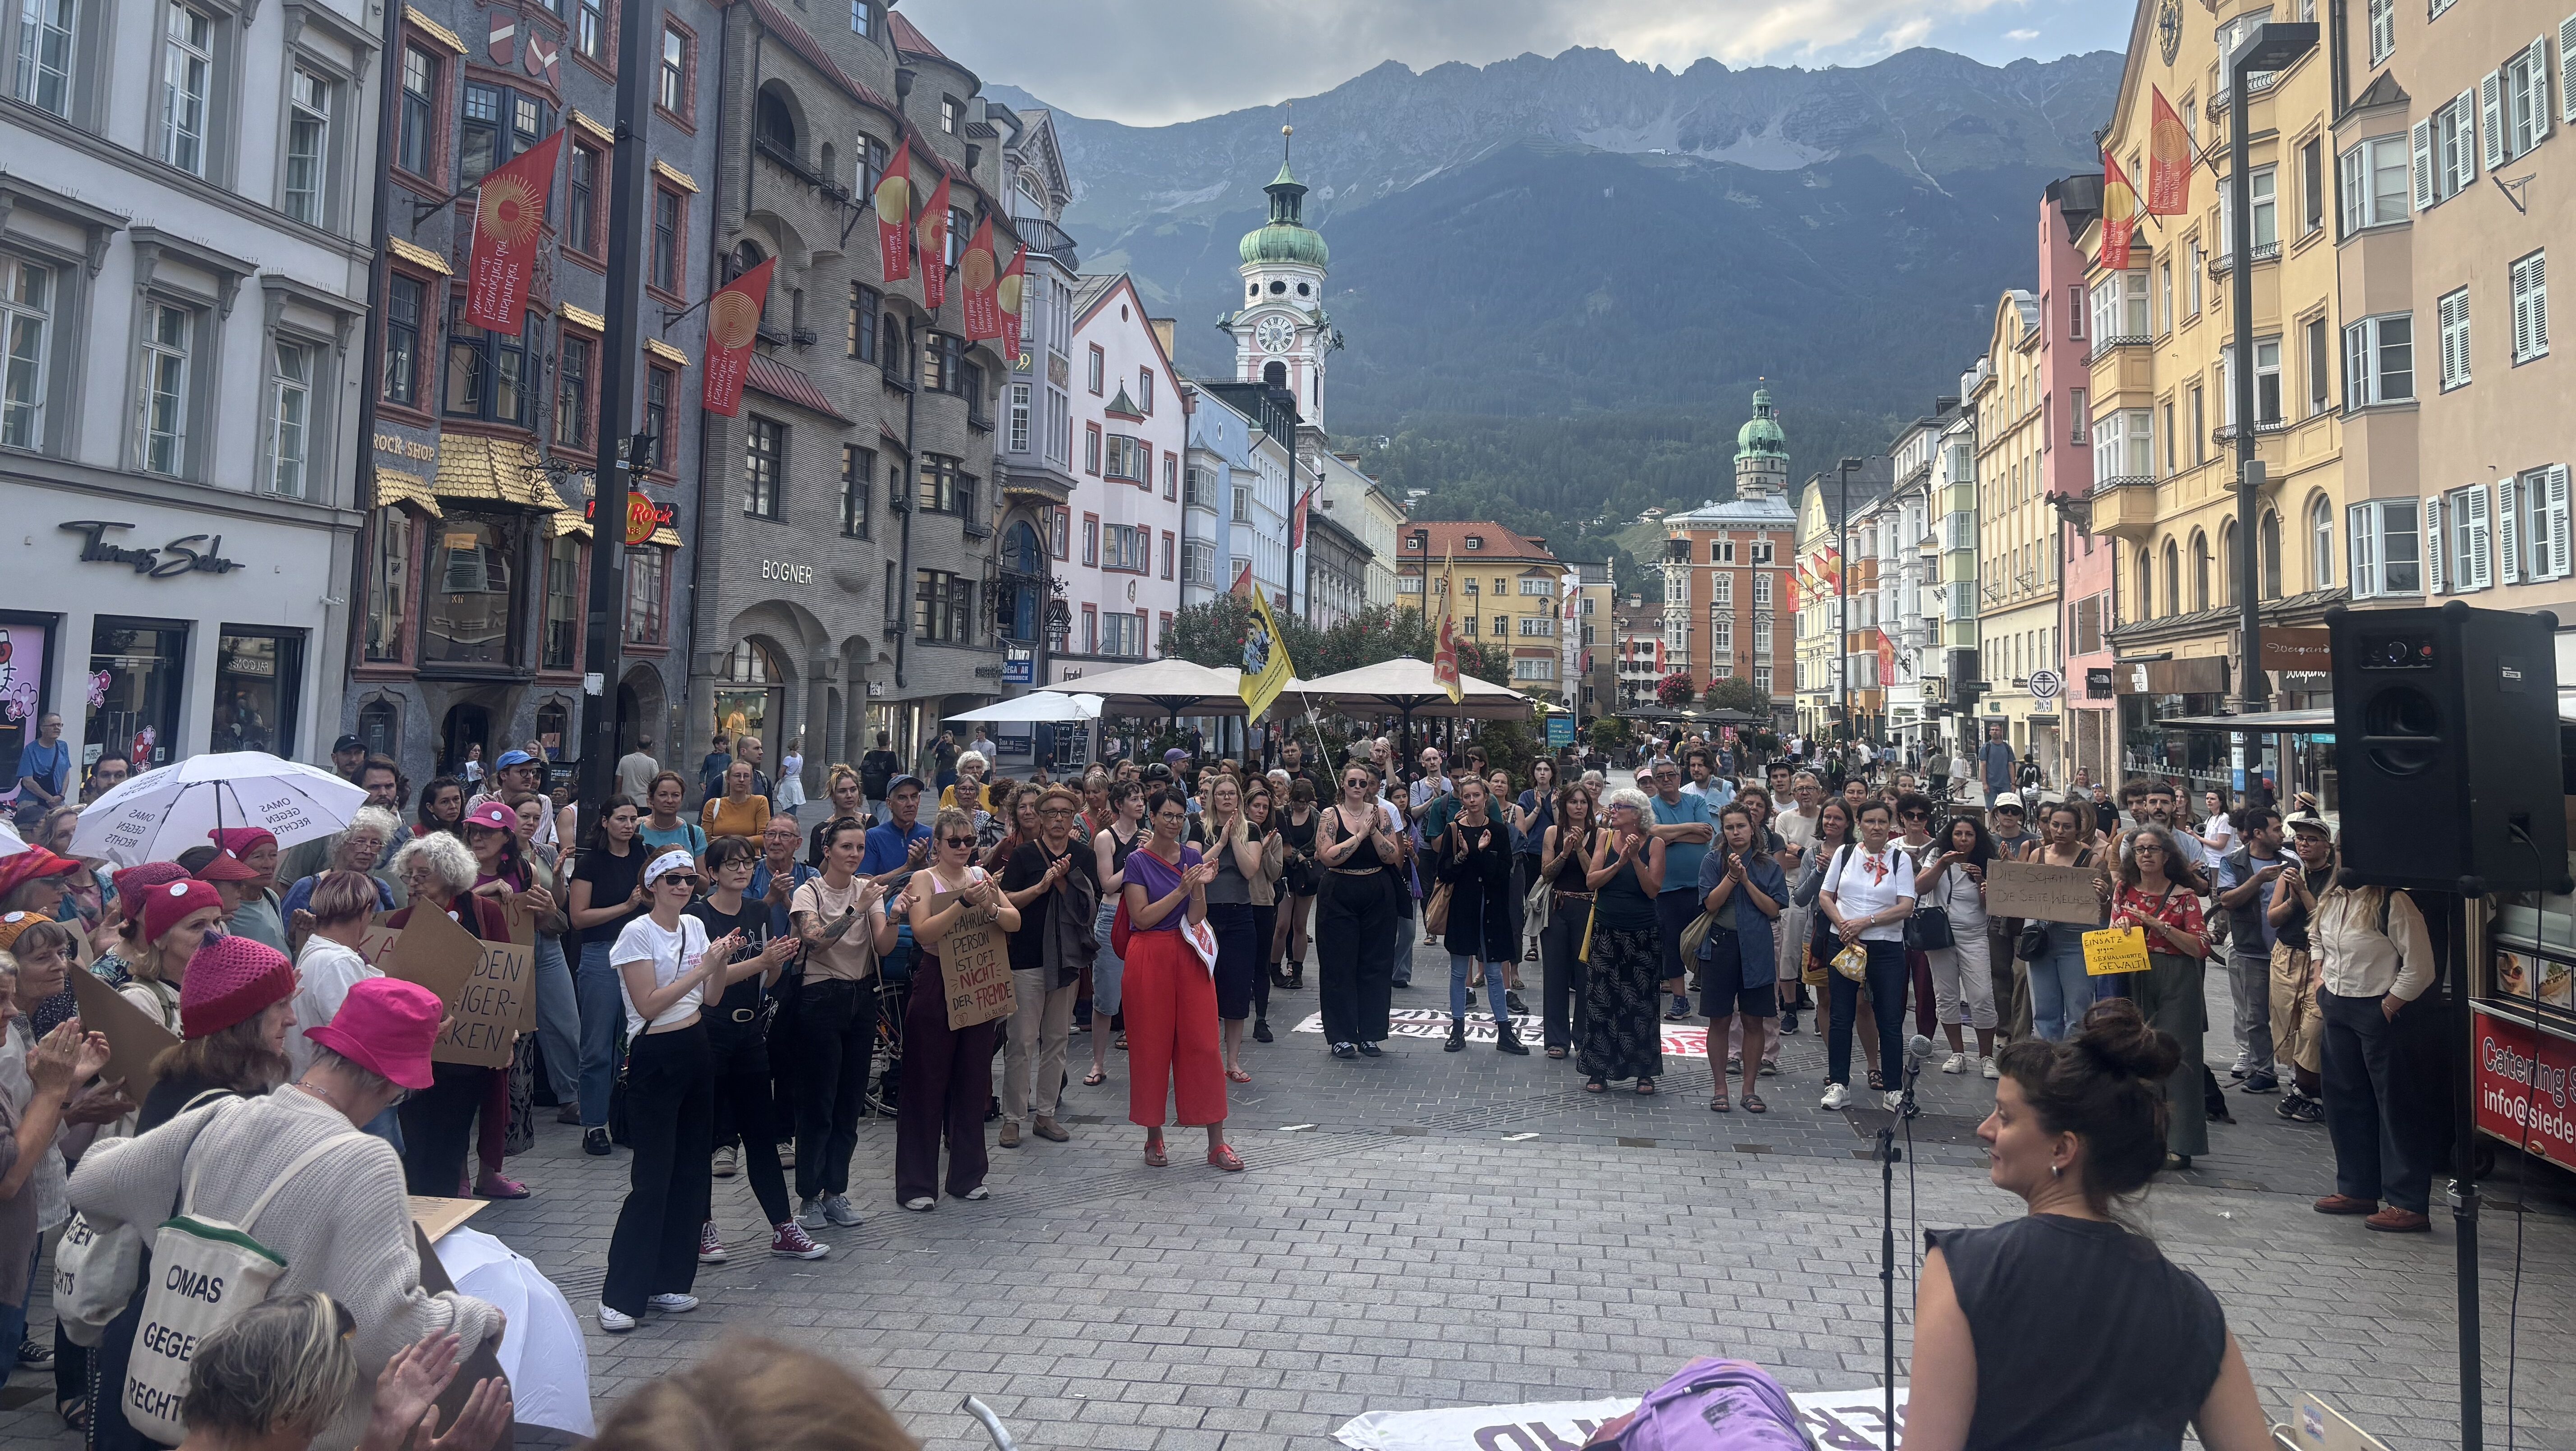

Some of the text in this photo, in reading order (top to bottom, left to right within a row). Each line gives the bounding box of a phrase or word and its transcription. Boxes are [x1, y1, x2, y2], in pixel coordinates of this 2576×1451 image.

[2151, 170, 2162, 208] Innsbrucker
[2161, 170, 2170, 208] Festwochen
[2170, 171, 2180, 208] Alten Musik
[373, 433, 434, 461] ROCK SHOP
[630, 502, 673, 525] Rock
[59, 520, 246, 578] Thomas Sabo
[763, 560, 813, 585] BOGNER
[2266, 643, 2330, 655] Weigand
[953, 931, 989, 956] PERSON
[2084, 937, 2123, 946] EINSATZ
[977, 950, 994, 966] OFT
[452, 986, 516, 1016] IGER-
[953, 981, 1012, 1010] DER FREMDE
[443, 1021, 504, 1052] KEN
[2483, 1036, 2566, 1108] Catering
[2484, 1083, 2576, 1143] info@siede
[166, 1265, 224, 1304] OMAS
[144, 1322, 196, 1362] GEGE
[129, 1376, 183, 1422] RECHT
